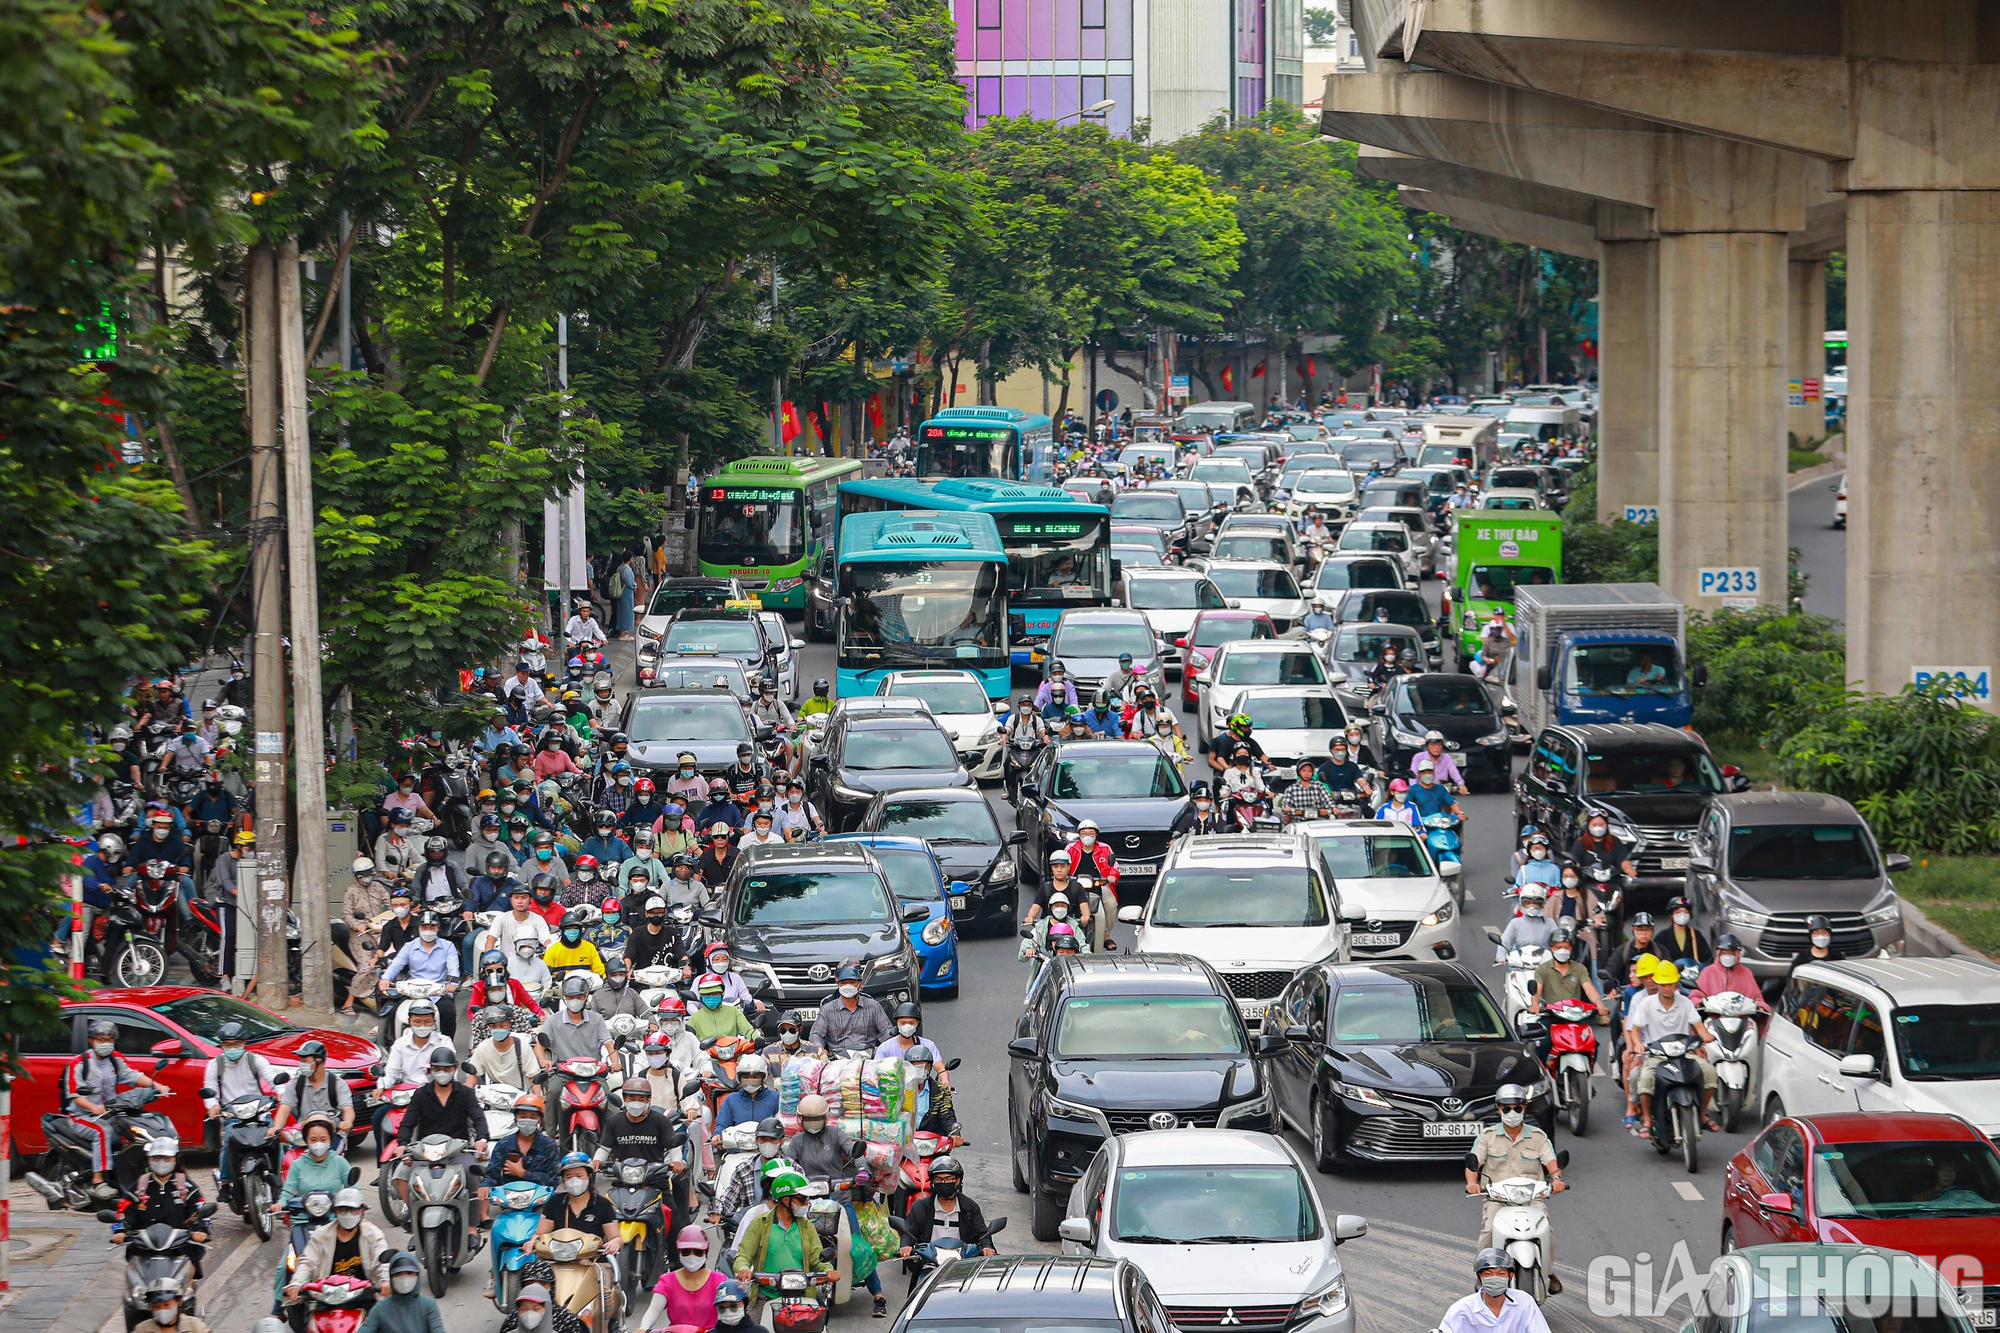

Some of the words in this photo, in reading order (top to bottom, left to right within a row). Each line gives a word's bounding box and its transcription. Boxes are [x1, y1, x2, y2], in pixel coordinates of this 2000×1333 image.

[927, 428, 943, 437] 20A
[744, 506, 754, 515] 13
[1477, 529, 1491, 540] XE
[1494, 528, 1515, 541] THƯ
[916, 573, 932, 584] 32
[1701, 571, 1757, 592] P233
[1425, 1124, 1481, 1135] 30F-961.21
[776, 1185, 790, 1193] Grab
